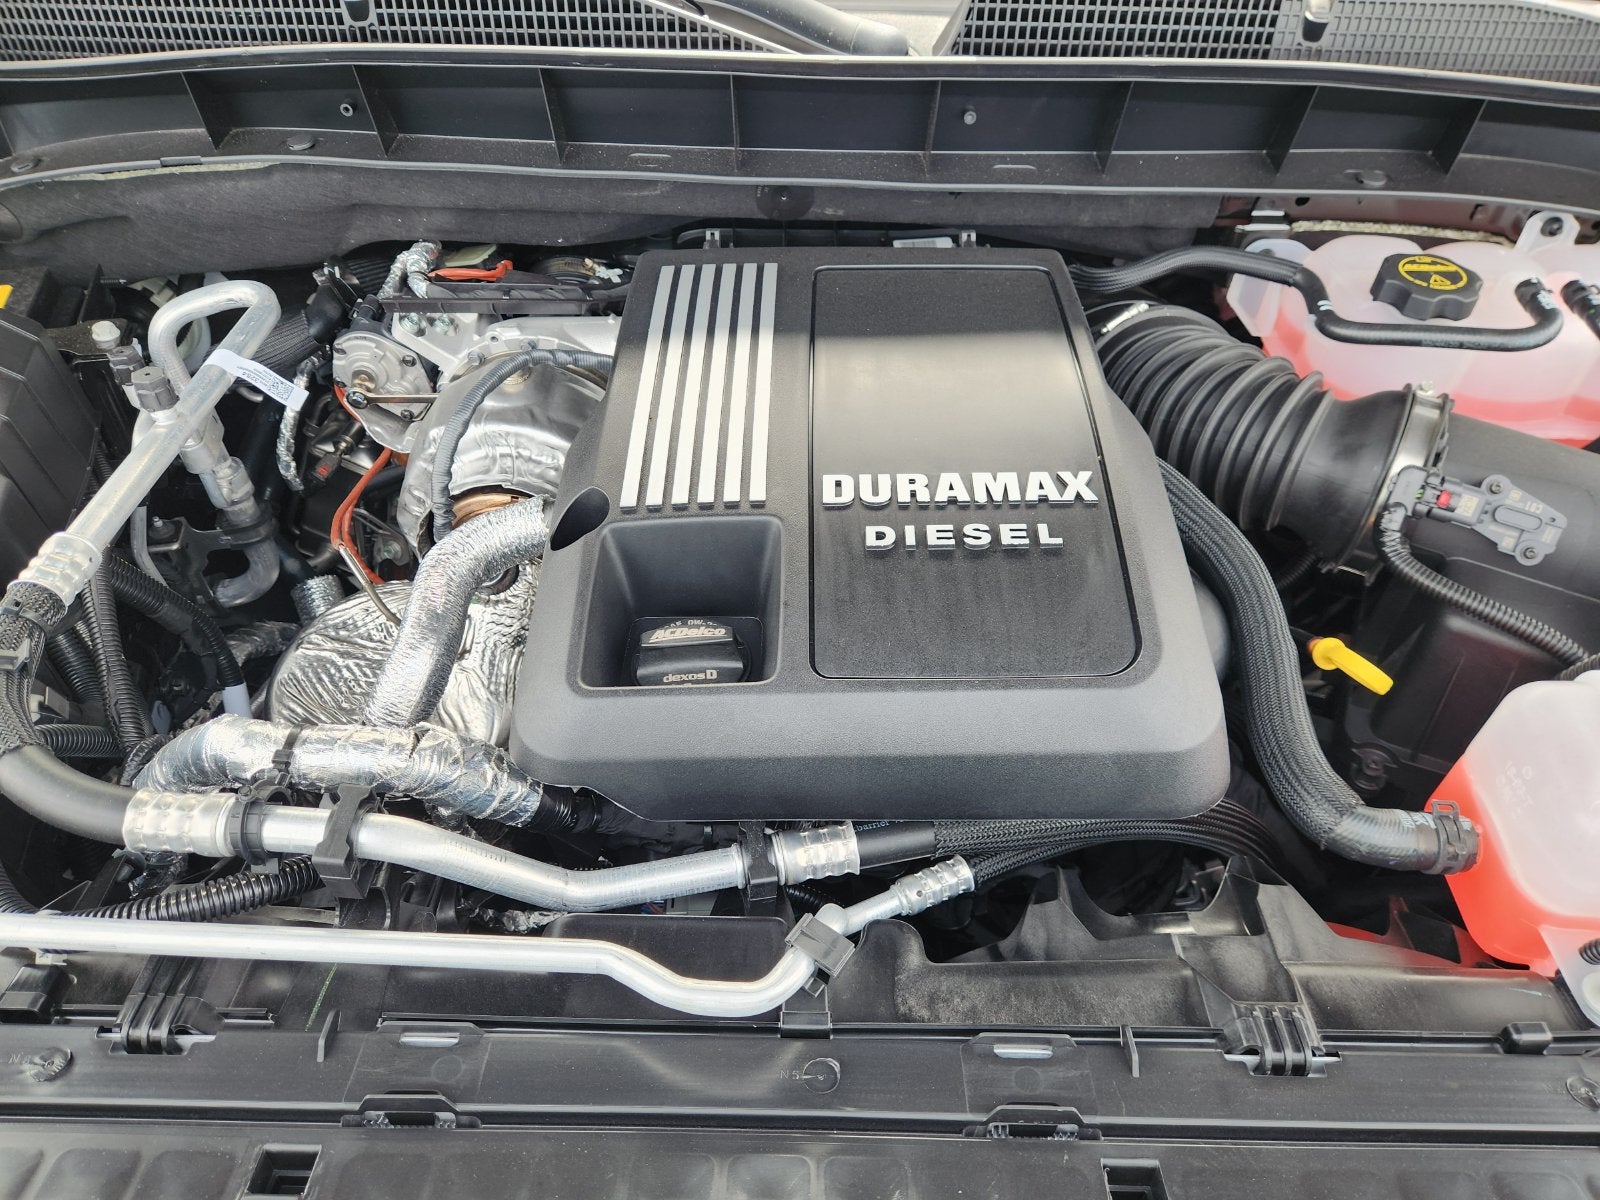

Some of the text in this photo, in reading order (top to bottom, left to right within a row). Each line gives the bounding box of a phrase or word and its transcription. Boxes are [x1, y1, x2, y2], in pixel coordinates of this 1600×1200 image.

[822, 470, 1099, 506] DURAMAX
[865, 523, 1064, 551] DIESEL
[687, 619, 717, 627] 0W-2
[649, 627, 726, 640] ACDelco
